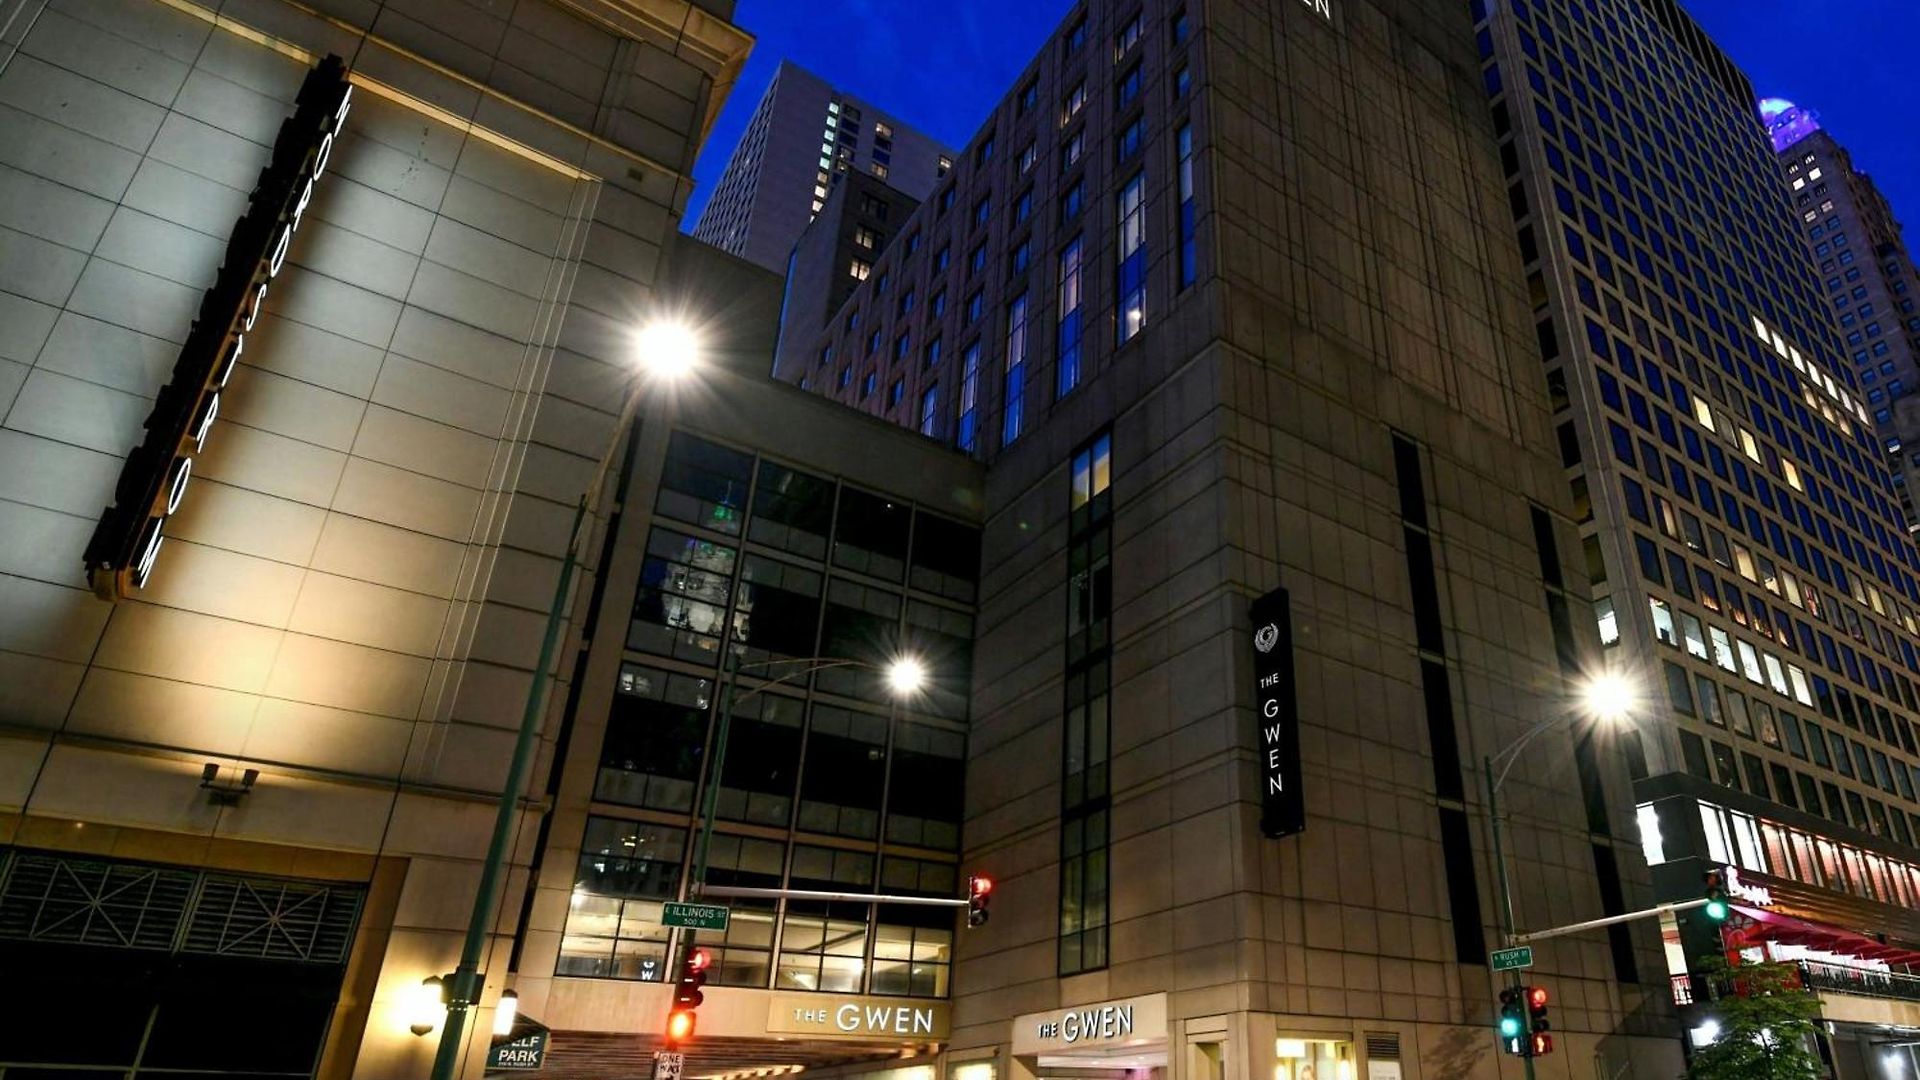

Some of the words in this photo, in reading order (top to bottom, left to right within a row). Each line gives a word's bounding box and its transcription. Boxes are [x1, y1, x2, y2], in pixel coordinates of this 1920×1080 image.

[138, 84, 353, 589] NORDSTROM
[1260, 673, 1279, 689] THE
[1264, 698, 1283, 795] GWEN
[672, 907, 715, 919] ILLINOIS
[794, 1008, 827, 1023] THE
[836, 1004, 933, 1033] GWEN
[1038, 1023, 1058, 1038] THE
[1062, 1005, 1133, 1042] GWEN
[498, 1049, 540, 1062] PARK
[660, 1055, 680, 1063] ONE
